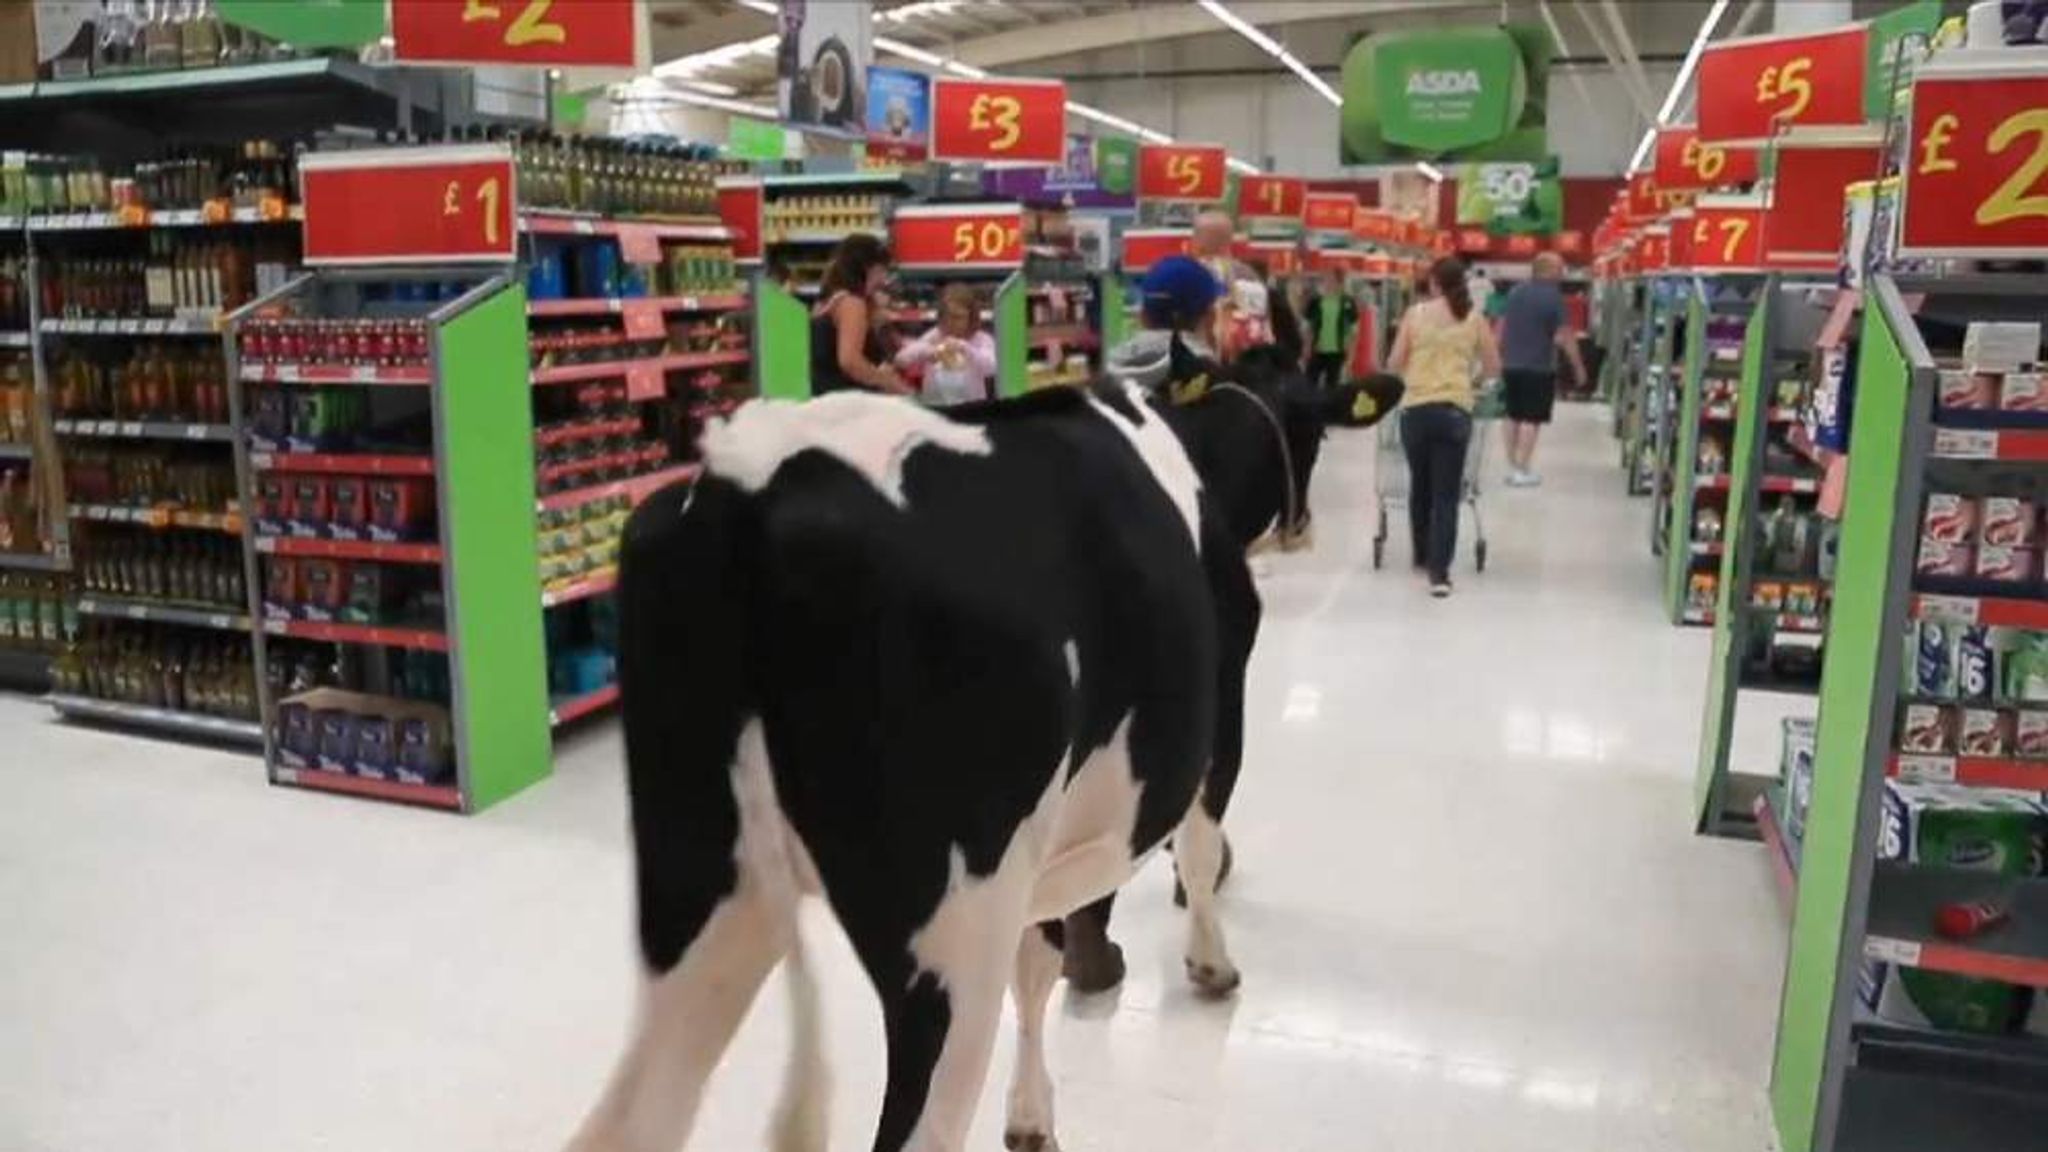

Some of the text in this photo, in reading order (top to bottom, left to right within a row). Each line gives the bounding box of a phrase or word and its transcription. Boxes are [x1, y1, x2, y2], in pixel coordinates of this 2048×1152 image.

[1405, 71, 1482, 95] ASDA
[1756, 58, 1811, 118] £5
[970, 94, 1021, 150] £3
[1167, 154, 1201, 193] £5
[1918, 108, 2048, 225] £2
[443, 177, 499, 244] £1
[1694, 217, 1749, 263] £7
